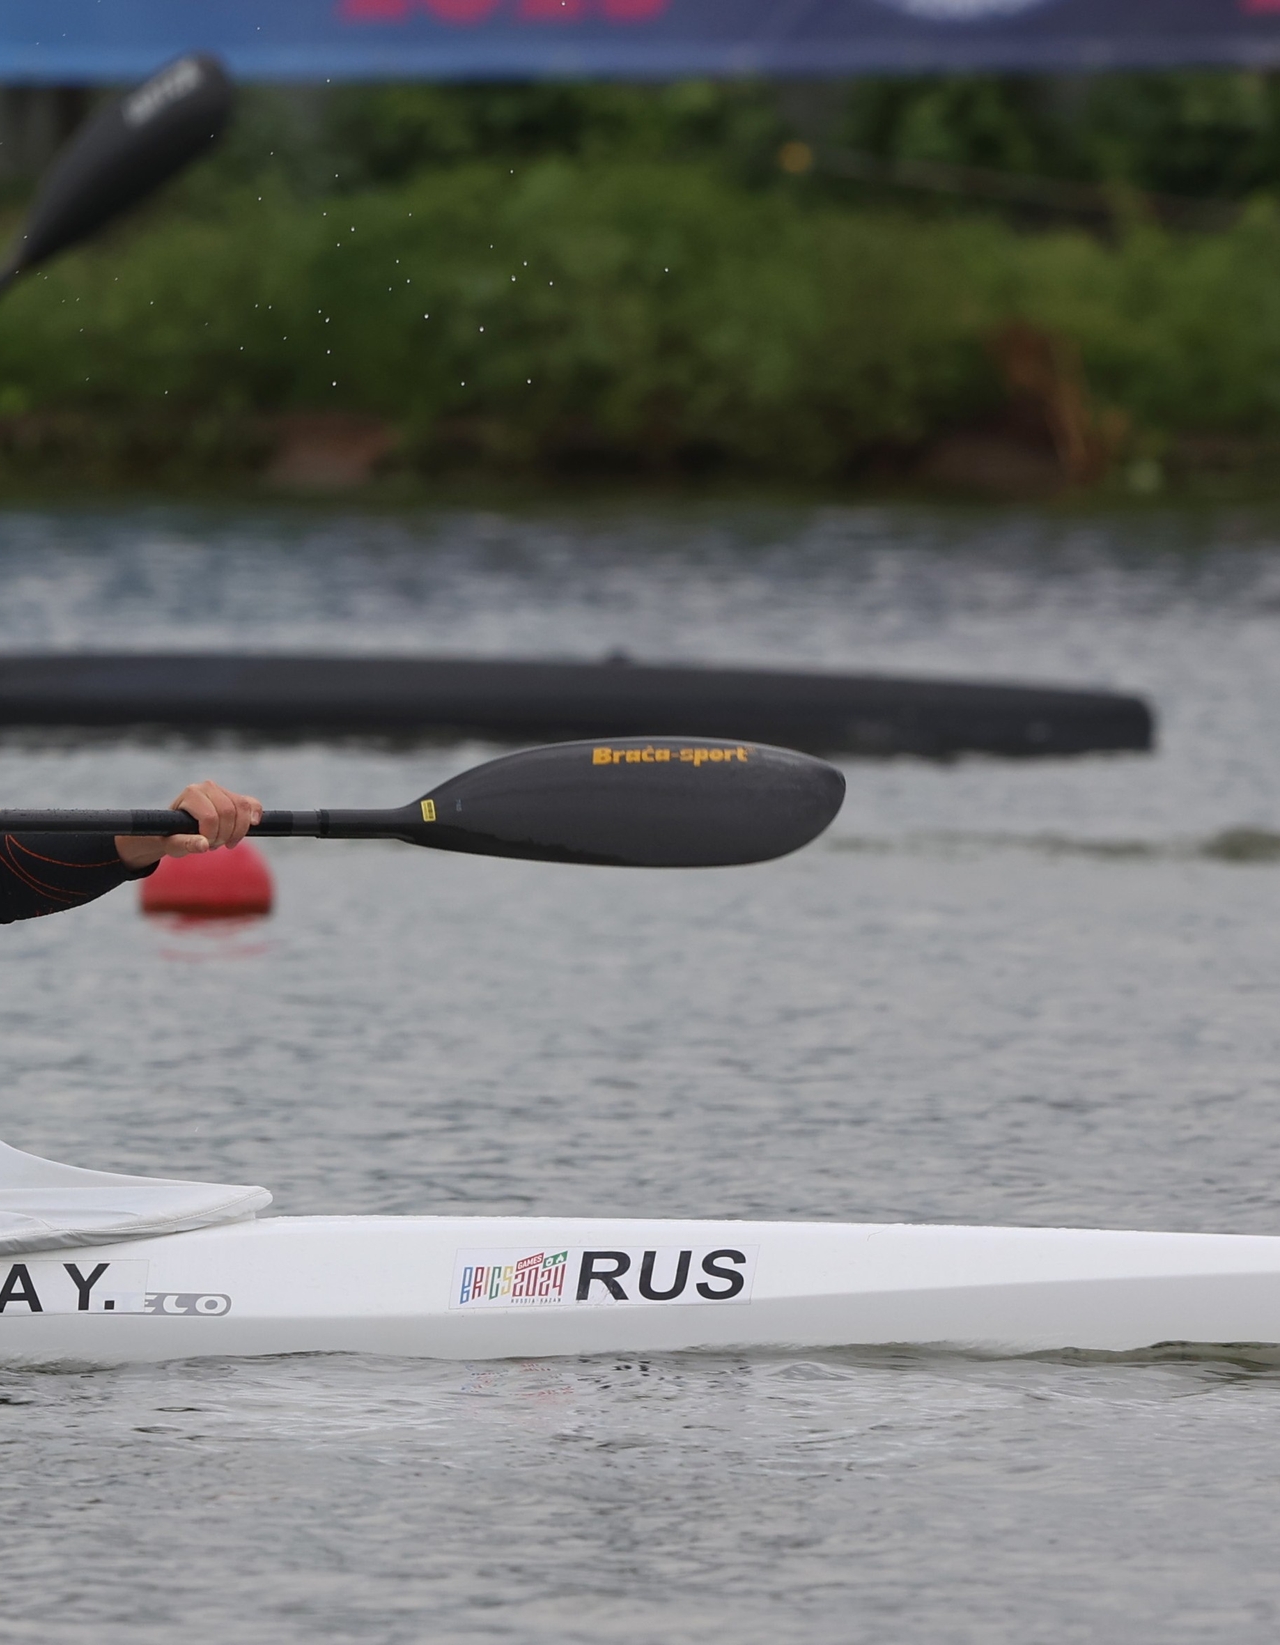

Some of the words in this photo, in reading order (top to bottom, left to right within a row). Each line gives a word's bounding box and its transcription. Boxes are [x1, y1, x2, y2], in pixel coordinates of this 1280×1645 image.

[63, 1263, 115, 1311] Y.
[460, 1266, 513, 1304] BRICS
[512, 1264, 566, 1297] 2024
[576, 1249, 747, 1301] RUS
